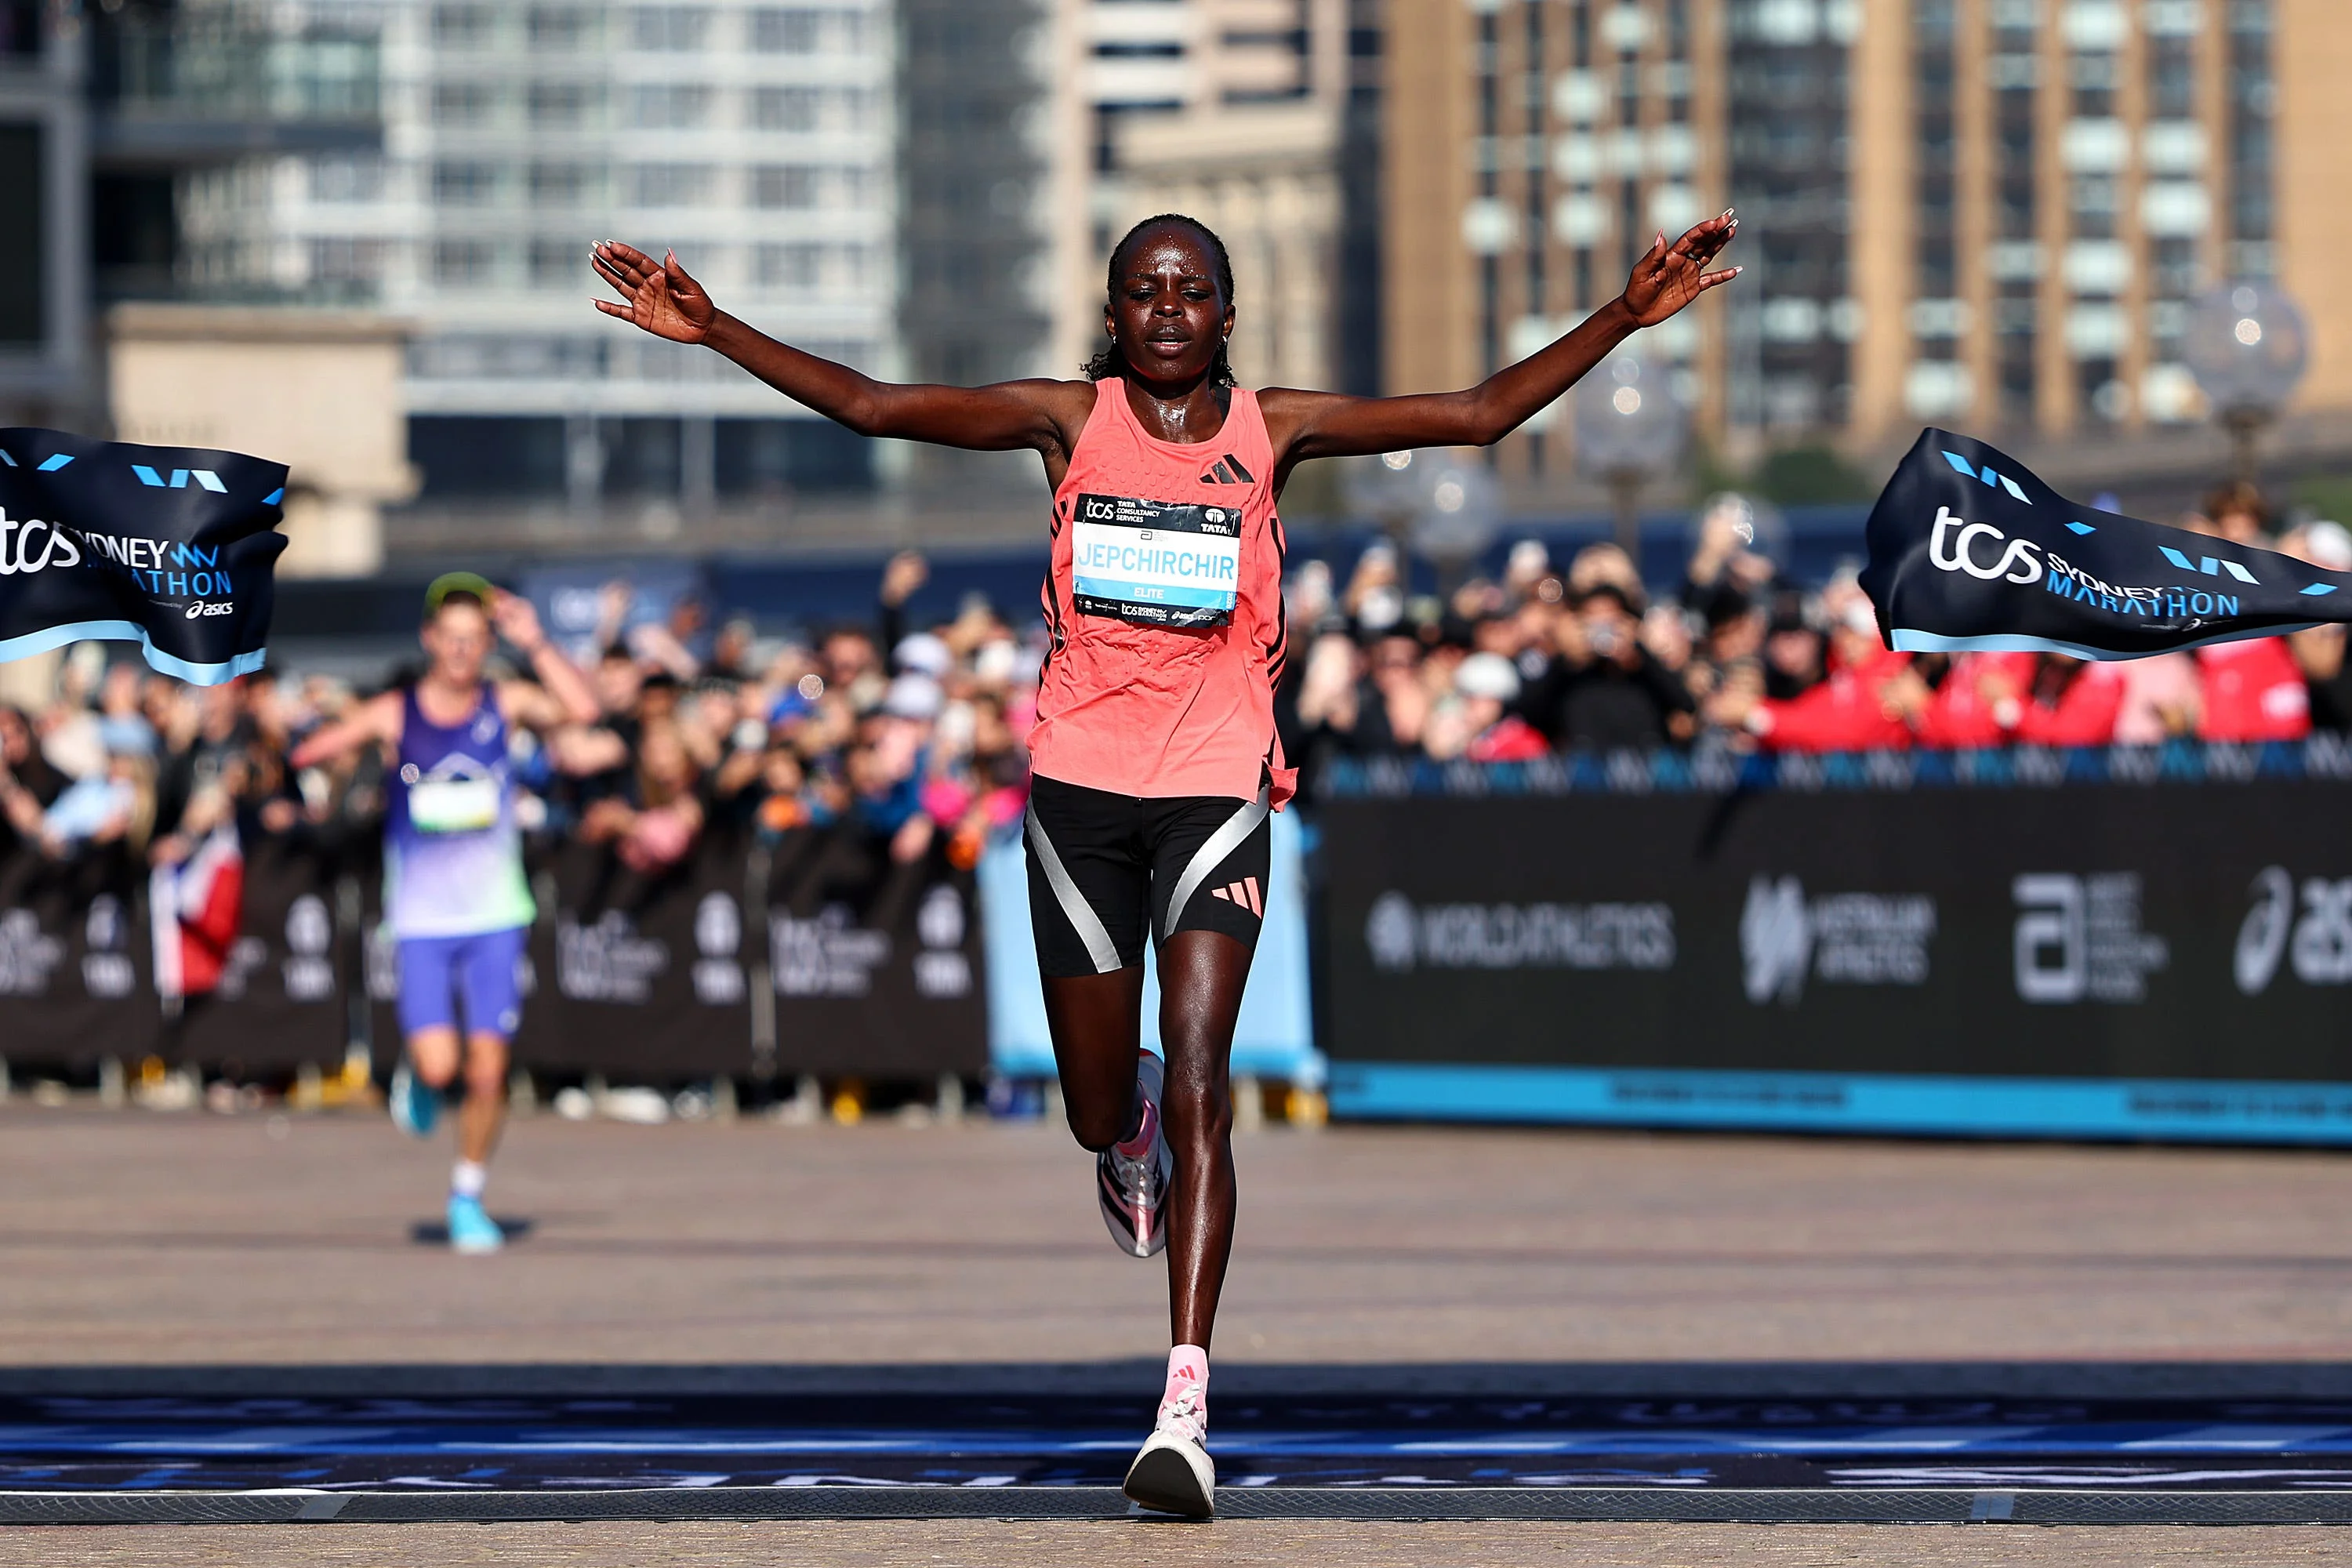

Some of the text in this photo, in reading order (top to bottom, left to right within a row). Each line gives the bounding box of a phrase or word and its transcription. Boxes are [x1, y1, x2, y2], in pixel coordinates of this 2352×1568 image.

[1086, 498, 1114, 520] tcs
[1116, 507, 1160, 517] CONSULTANCY
[1116, 514, 1144, 523] SERVICES
[1200, 523, 1228, 535] TATA
[74, 530, 169, 569] YDNEY
[1929, 506, 2043, 584] tcs
[1078, 543, 1234, 580] JEPCHIRCHIR
[2047, 552, 2164, 601] SYDNEY
[1134, 586, 1165, 600] ELITE
[2046, 569, 2240, 618] MARATHON
[202, 601, 234, 616] asics
